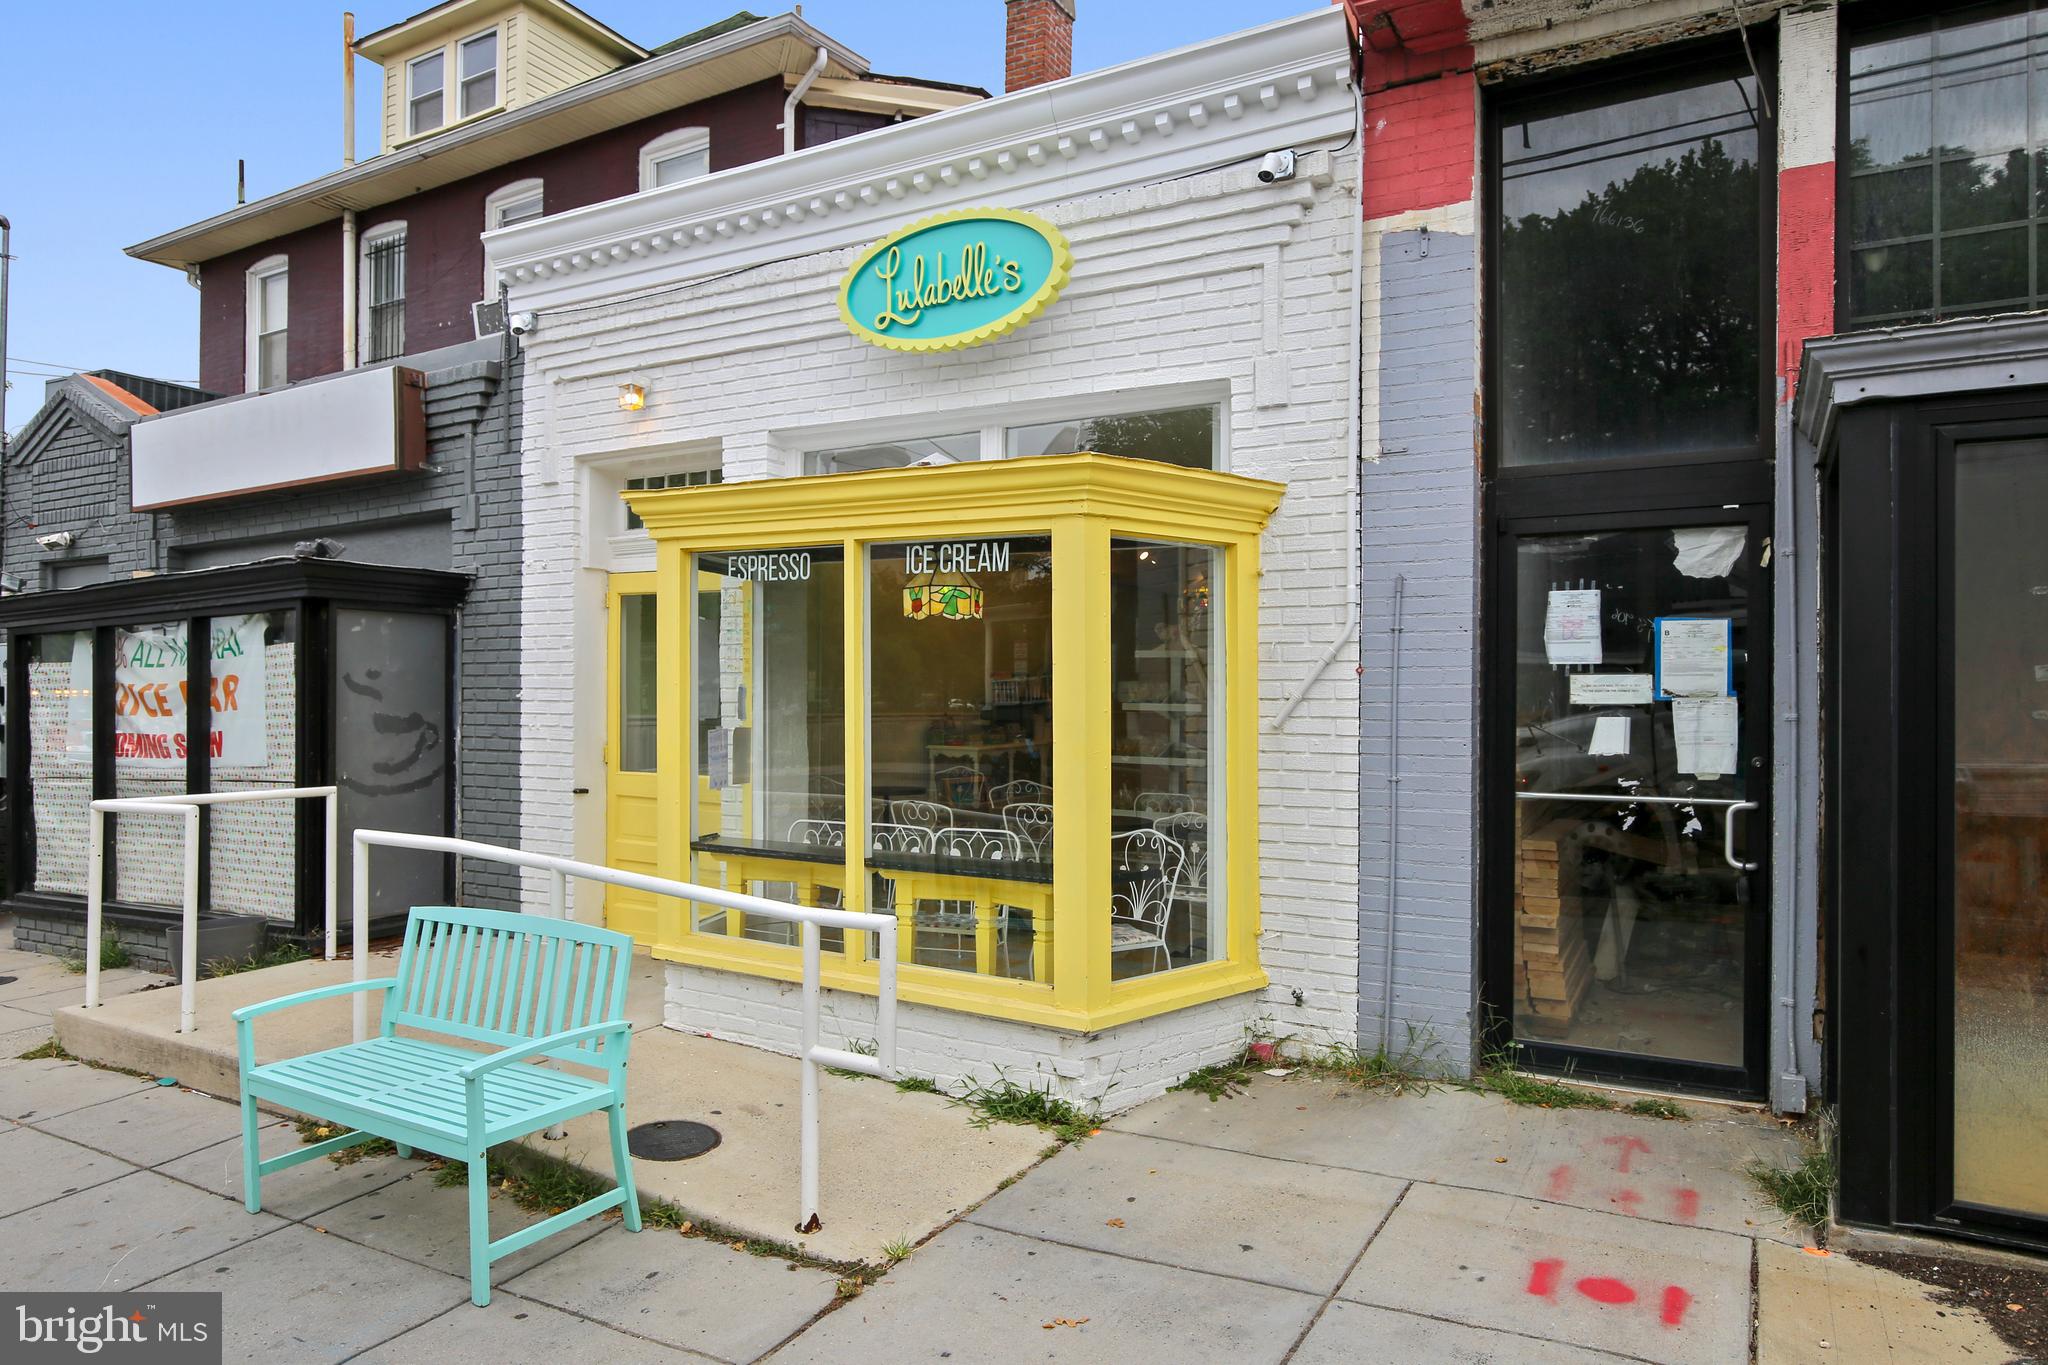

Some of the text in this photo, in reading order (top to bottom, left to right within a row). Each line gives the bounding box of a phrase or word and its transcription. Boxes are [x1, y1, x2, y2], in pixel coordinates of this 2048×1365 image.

[874, 241, 1021, 330] Lulabelle's
[728, 552, 811, 582] ESPRESSO
[905, 542, 1010, 574] ICE CREAM
[131, 640, 165, 668] ALL
[115, 682, 173, 718] UICE
[115, 730, 223, 759] OMING SN
